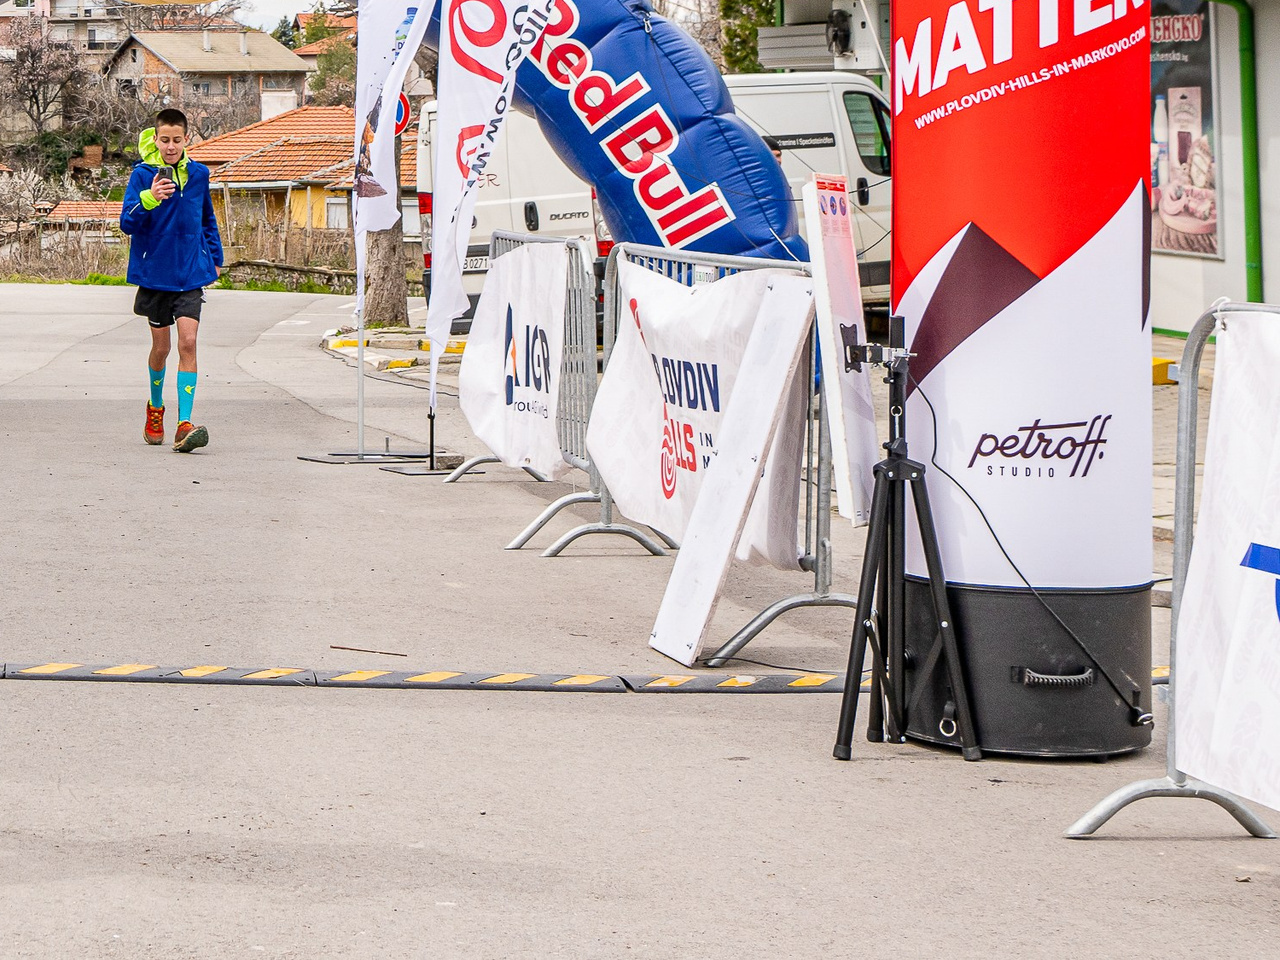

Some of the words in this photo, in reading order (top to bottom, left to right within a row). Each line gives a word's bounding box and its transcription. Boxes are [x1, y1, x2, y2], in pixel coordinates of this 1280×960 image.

[1150, 14, 1202, 43] ЕНСКО
[914, 25, 1146, 130] WWW.PLOVDIV-HILLS-IN-MARKOVO.COM
[605, 109, 728, 248] Bull
[549, 211, 590, 221] DUCATO
[652, 354, 720, 412] POVDIV
[987, 465, 1055, 478] STUDIO
